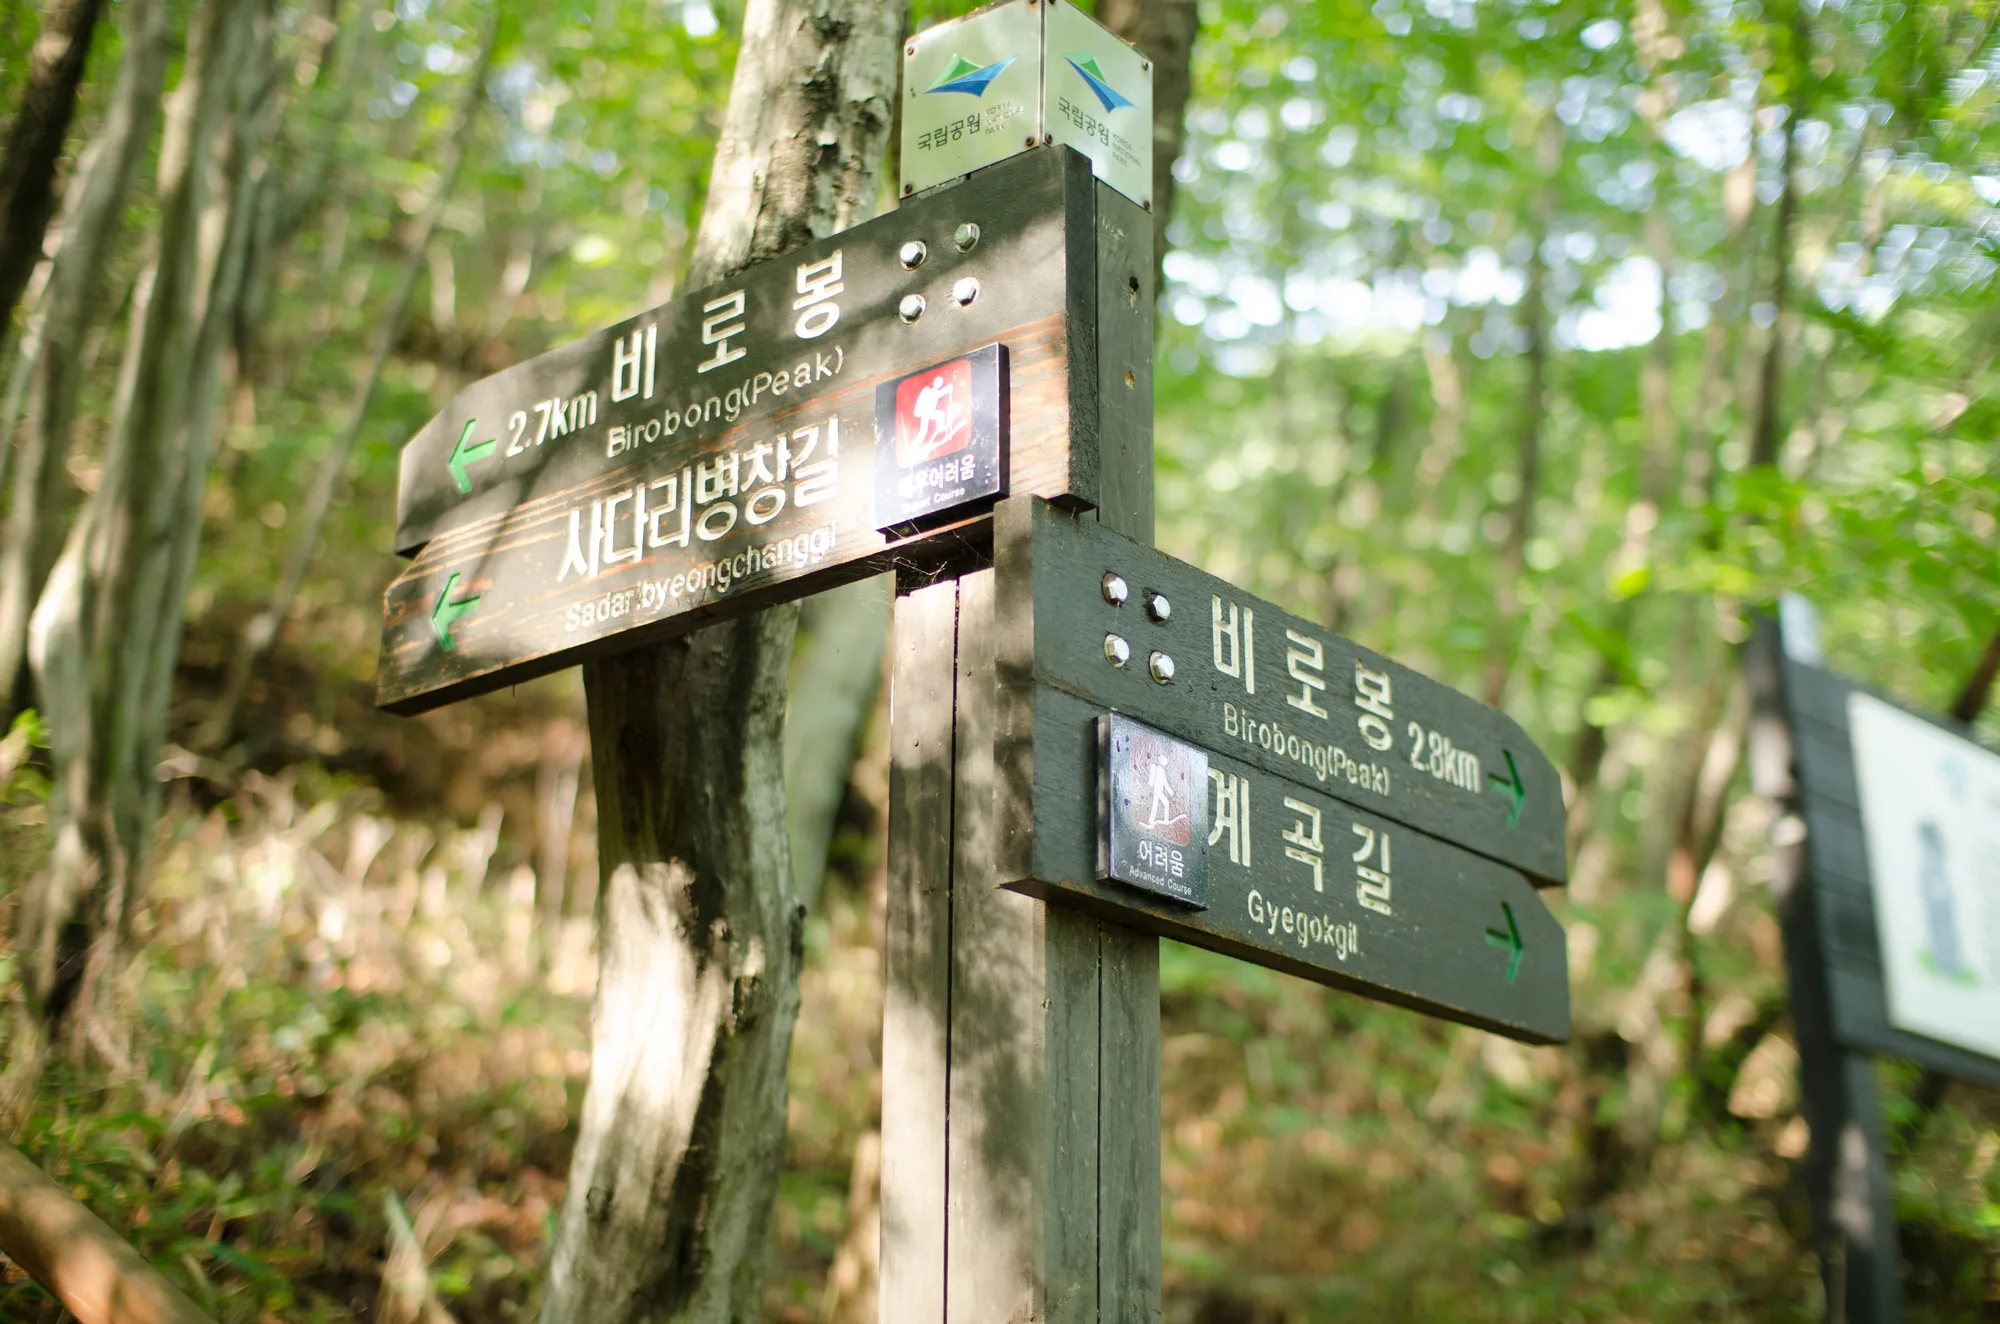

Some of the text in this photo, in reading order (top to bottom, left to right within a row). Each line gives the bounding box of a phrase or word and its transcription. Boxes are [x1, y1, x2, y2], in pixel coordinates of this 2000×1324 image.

[917, 112, 981, 152] 국립공원
[1058, 96, 1110, 148] 국립공원
[505, 388, 598, 458] 2.7km
[606, 344, 844, 458] Birobong(Peak)
[556, 413, 840, 583] 사다리병창길
[933, 486, 966, 505] Course
[1223, 701, 1392, 797] Birobong(Peak)
[1406, 720, 1483, 794] 2.8km
[1138, 838, 1186, 880] 어려움
[1207, 765, 1393, 917] 계곡길
[1128, 864, 1193, 896] Advanced Course
[1246, 888, 1359, 963] Gyegokgil
